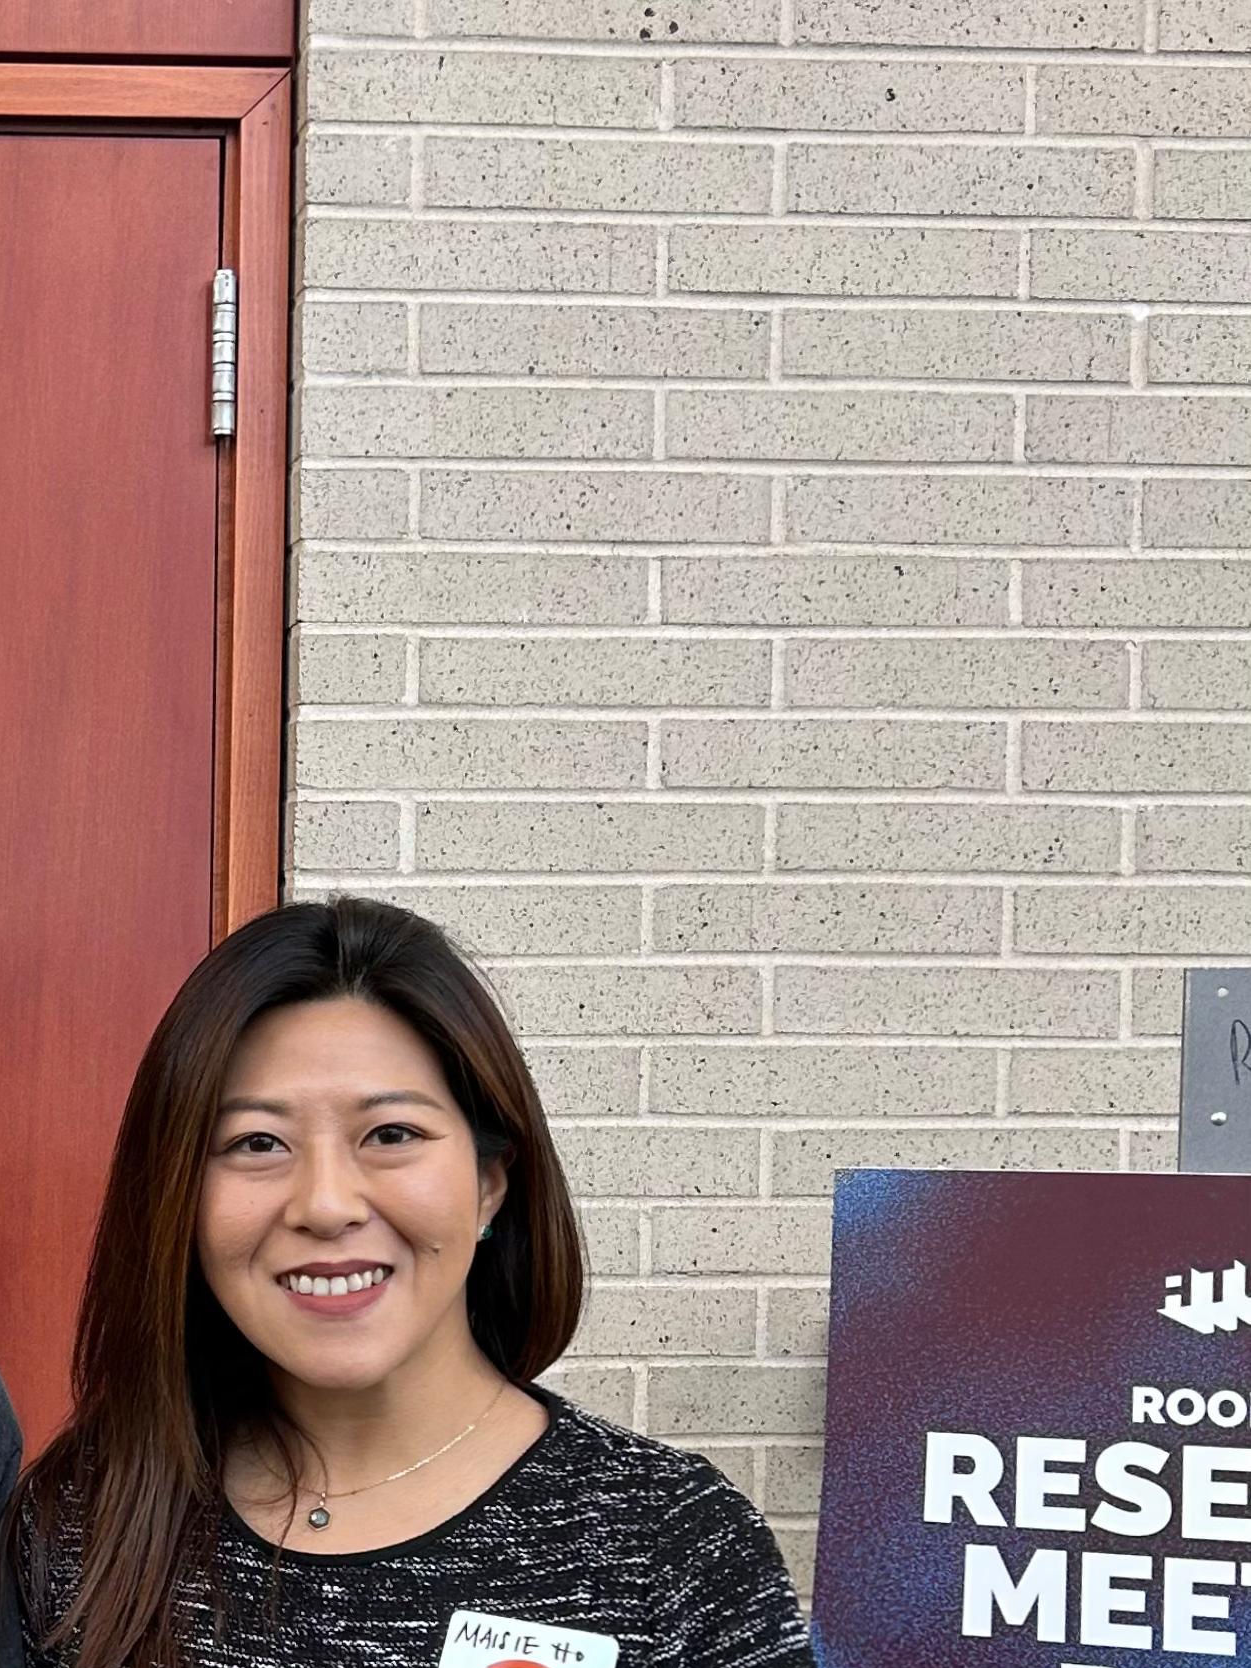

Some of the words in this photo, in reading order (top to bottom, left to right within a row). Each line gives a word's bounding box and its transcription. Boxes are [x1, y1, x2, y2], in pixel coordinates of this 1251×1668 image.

[1131, 1385, 1251, 1428] ROO
[923, 1431, 1251, 1543] RESE
[454, 1621, 540, 1655] MAISIE
[961, 1543, 1251, 1656] MEE
